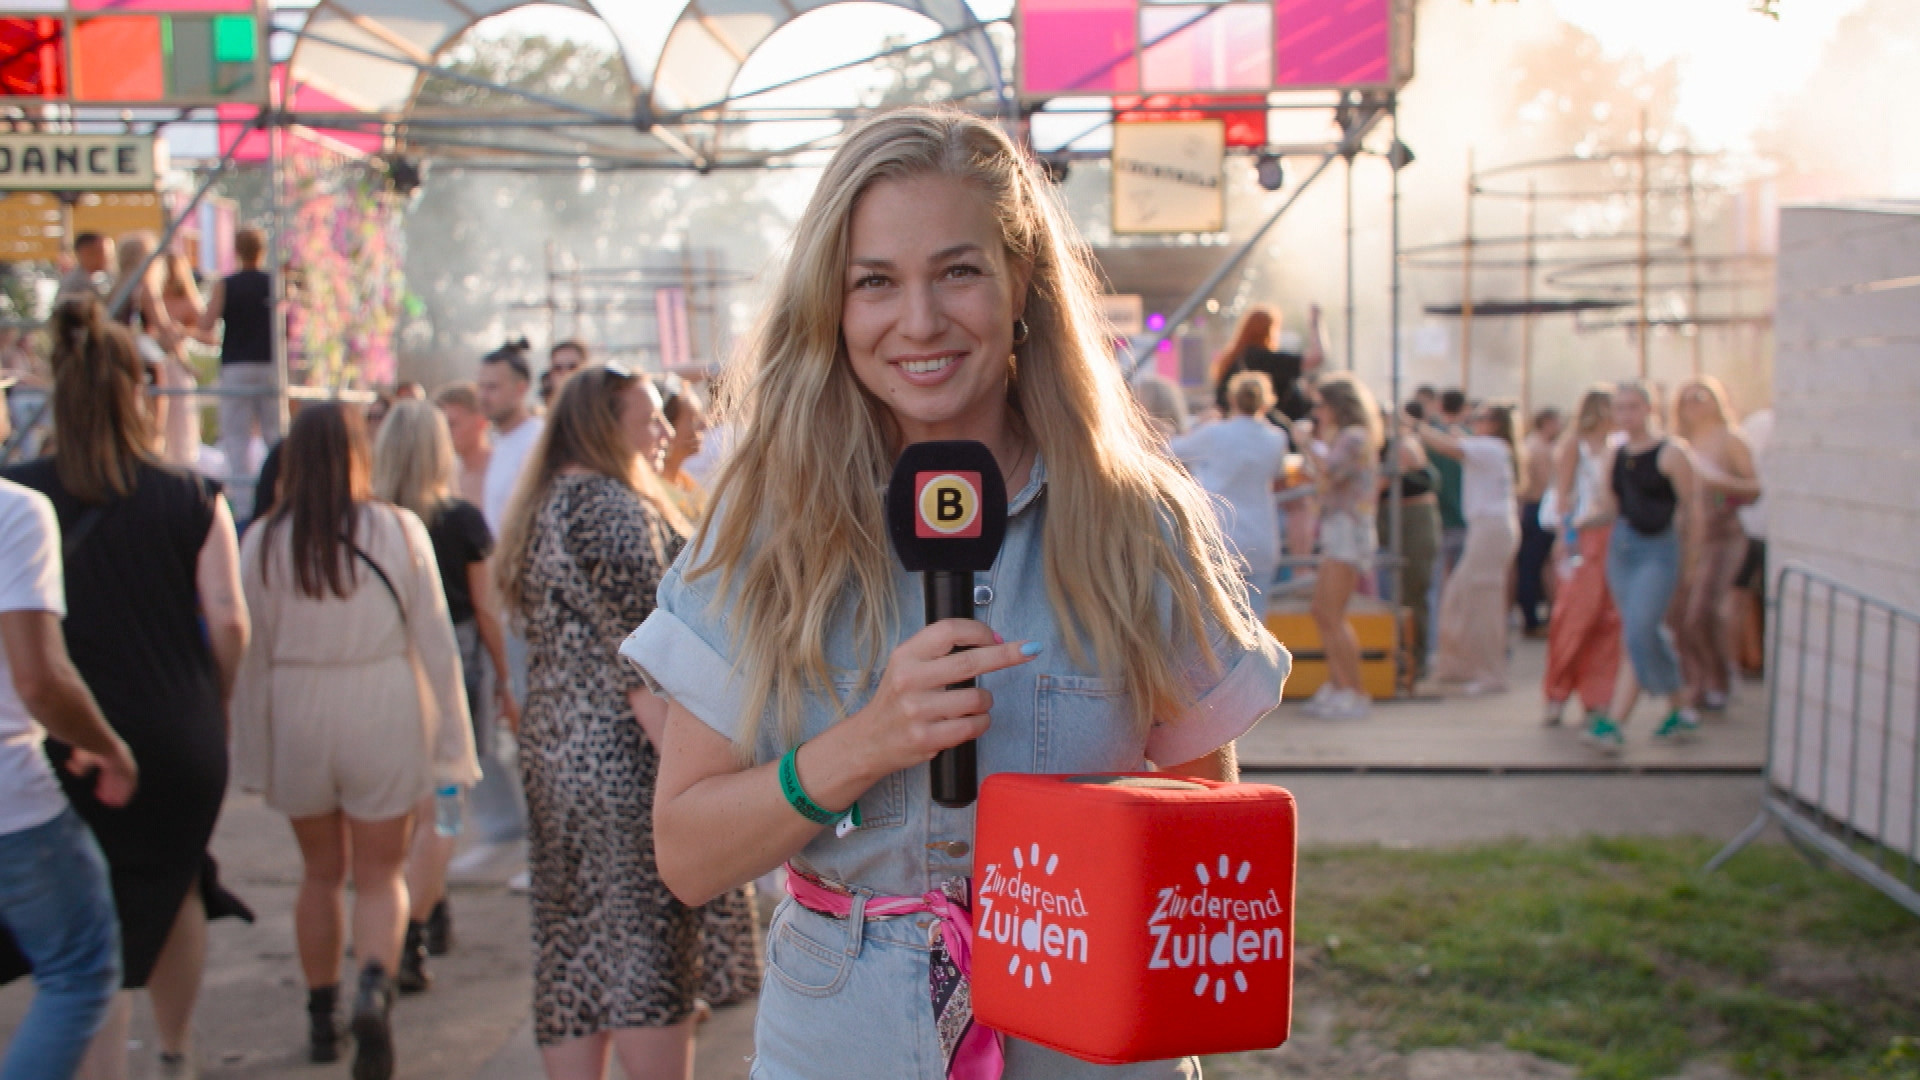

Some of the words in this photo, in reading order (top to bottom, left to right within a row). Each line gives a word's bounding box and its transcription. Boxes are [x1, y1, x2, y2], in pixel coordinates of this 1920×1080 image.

[0, 146, 137, 174] DANCE
[937, 487, 964, 521] B
[979, 864, 1089, 917] Zinderend
[1148, 885, 1284, 925] Zinderend
[978, 898, 1088, 963] Zuiden
[1148, 921, 1284, 969] Zuiden
